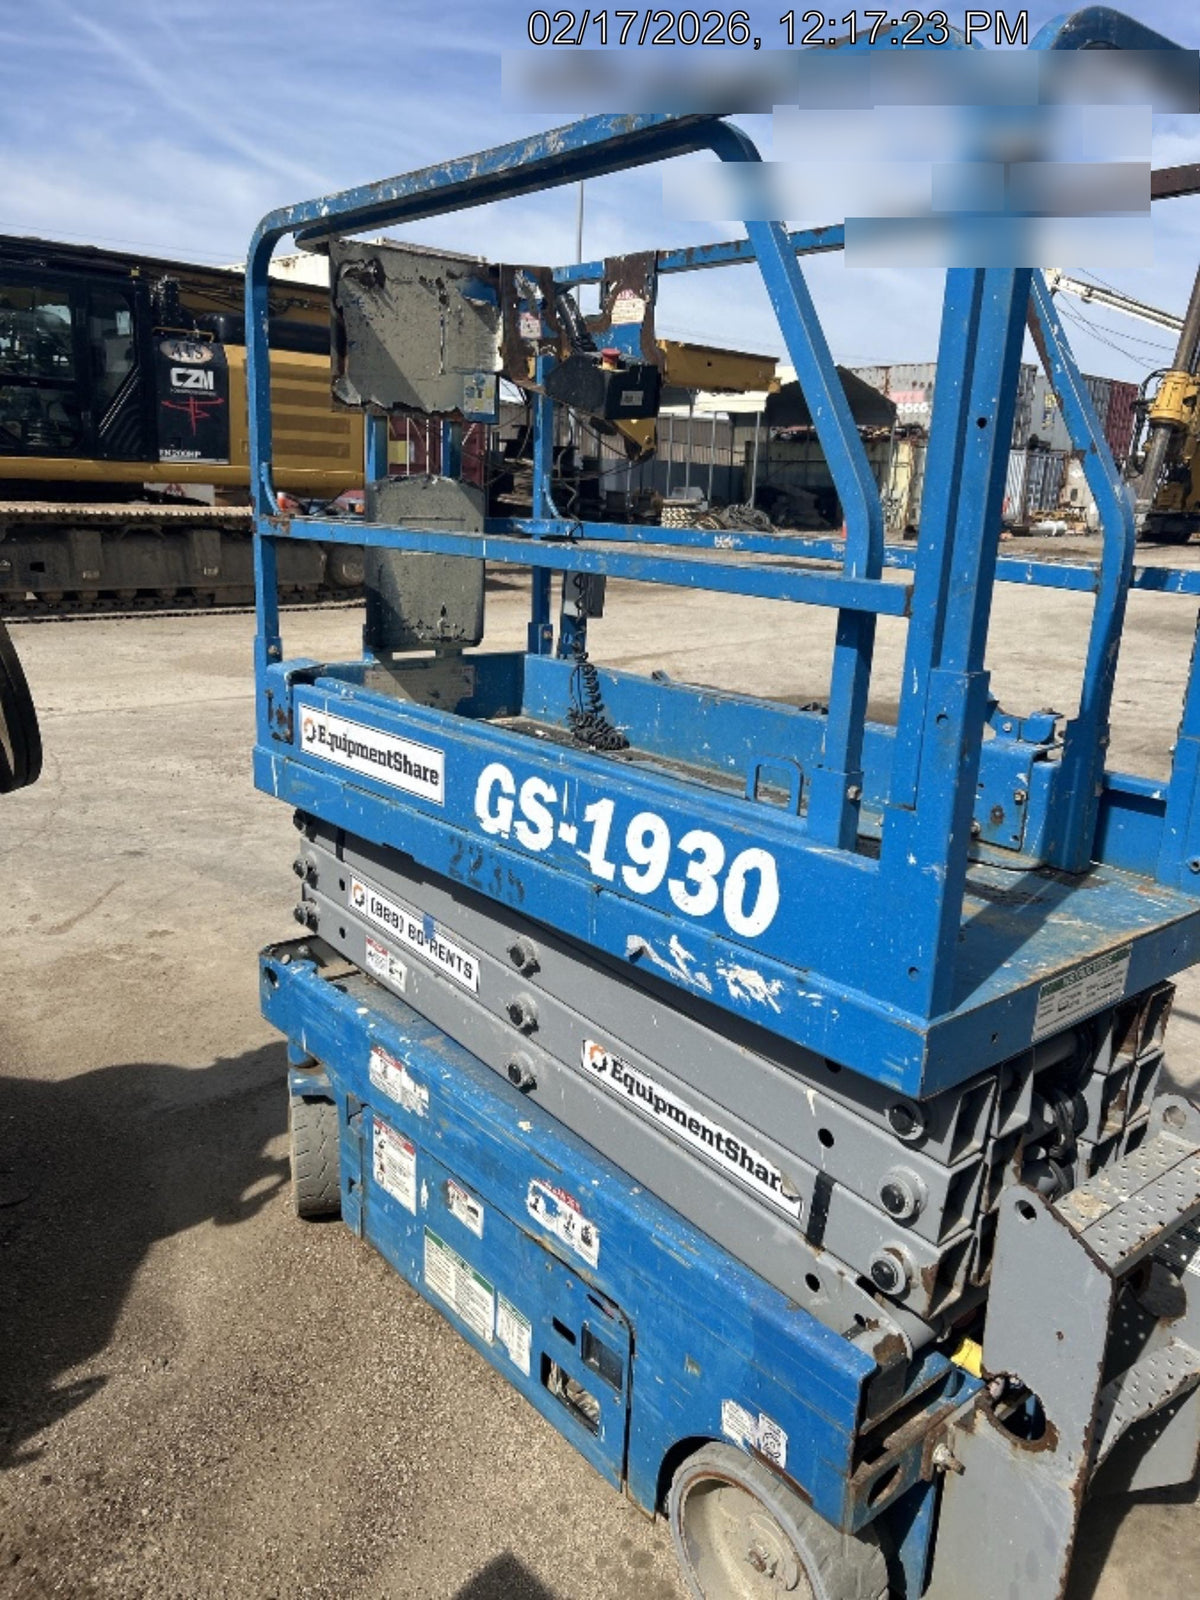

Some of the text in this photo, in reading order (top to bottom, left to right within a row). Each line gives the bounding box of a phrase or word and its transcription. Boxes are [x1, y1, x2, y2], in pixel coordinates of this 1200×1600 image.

[170, 367, 214, 391] CZM
[317, 724, 440, 787] EquipmentShare
[473, 762, 781, 938] GS-1930
[370, 897, 405, 934] (888)
[610, 1056, 784, 1193] EquipmentShar
